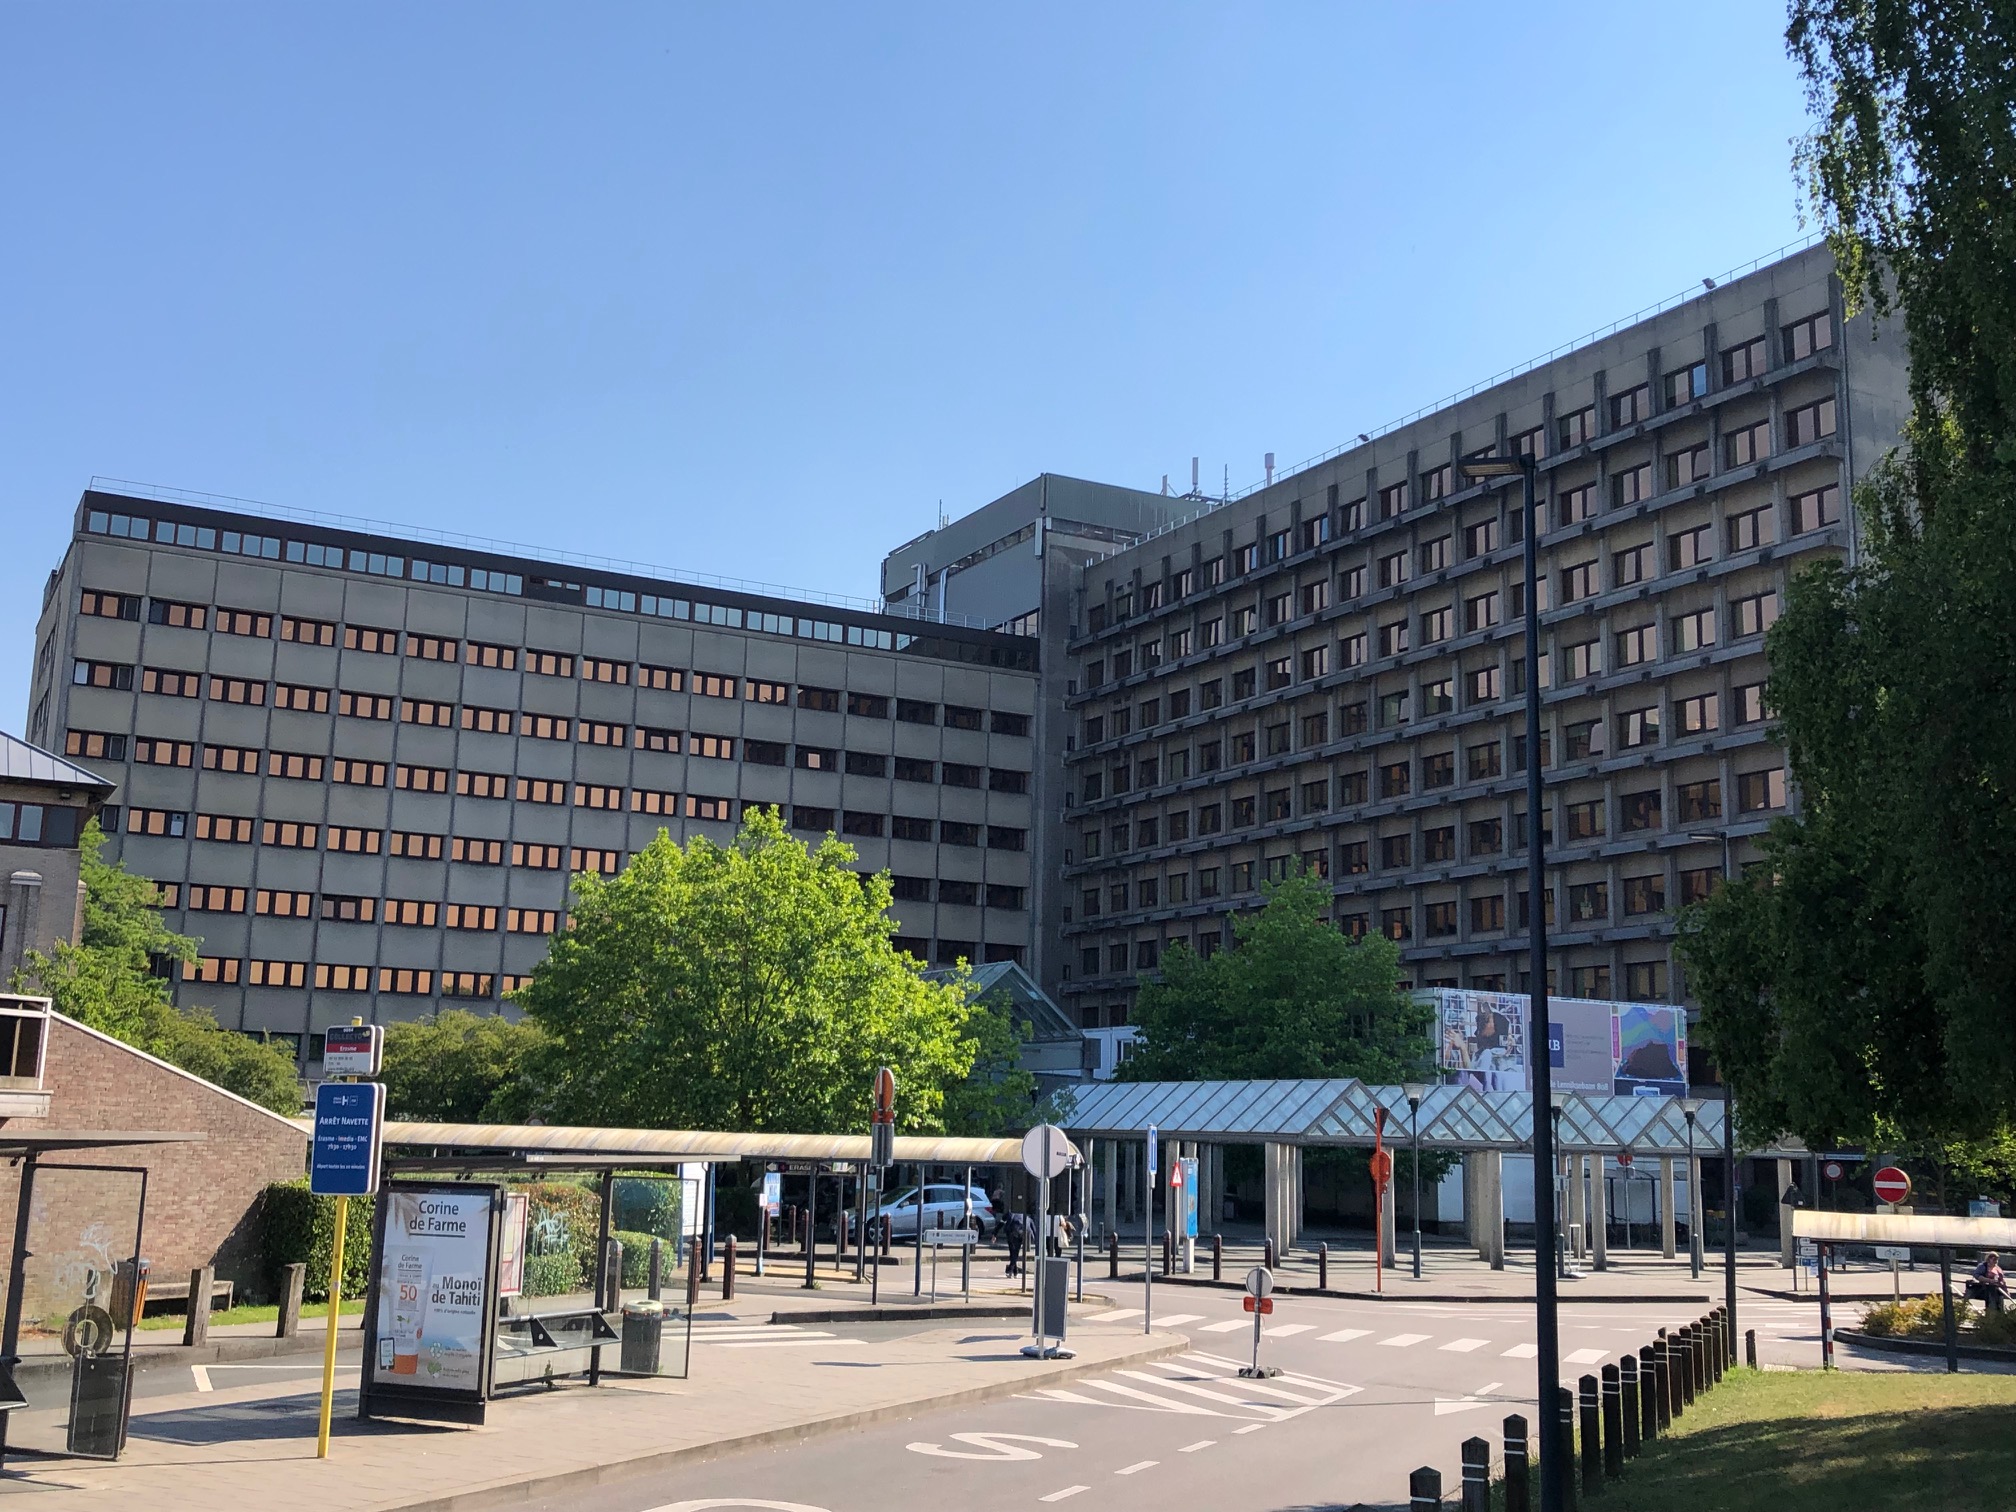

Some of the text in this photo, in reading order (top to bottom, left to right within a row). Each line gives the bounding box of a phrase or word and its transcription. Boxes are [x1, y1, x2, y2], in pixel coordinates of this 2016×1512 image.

[418, 1200, 459, 1216] Corine
[409, 1216, 466, 1232] de Farme
[442, 1276, 482, 1291] Monoï
[400, 1284, 417, 1301] 50
[432, 1290, 480, 1306] de Tahiti
